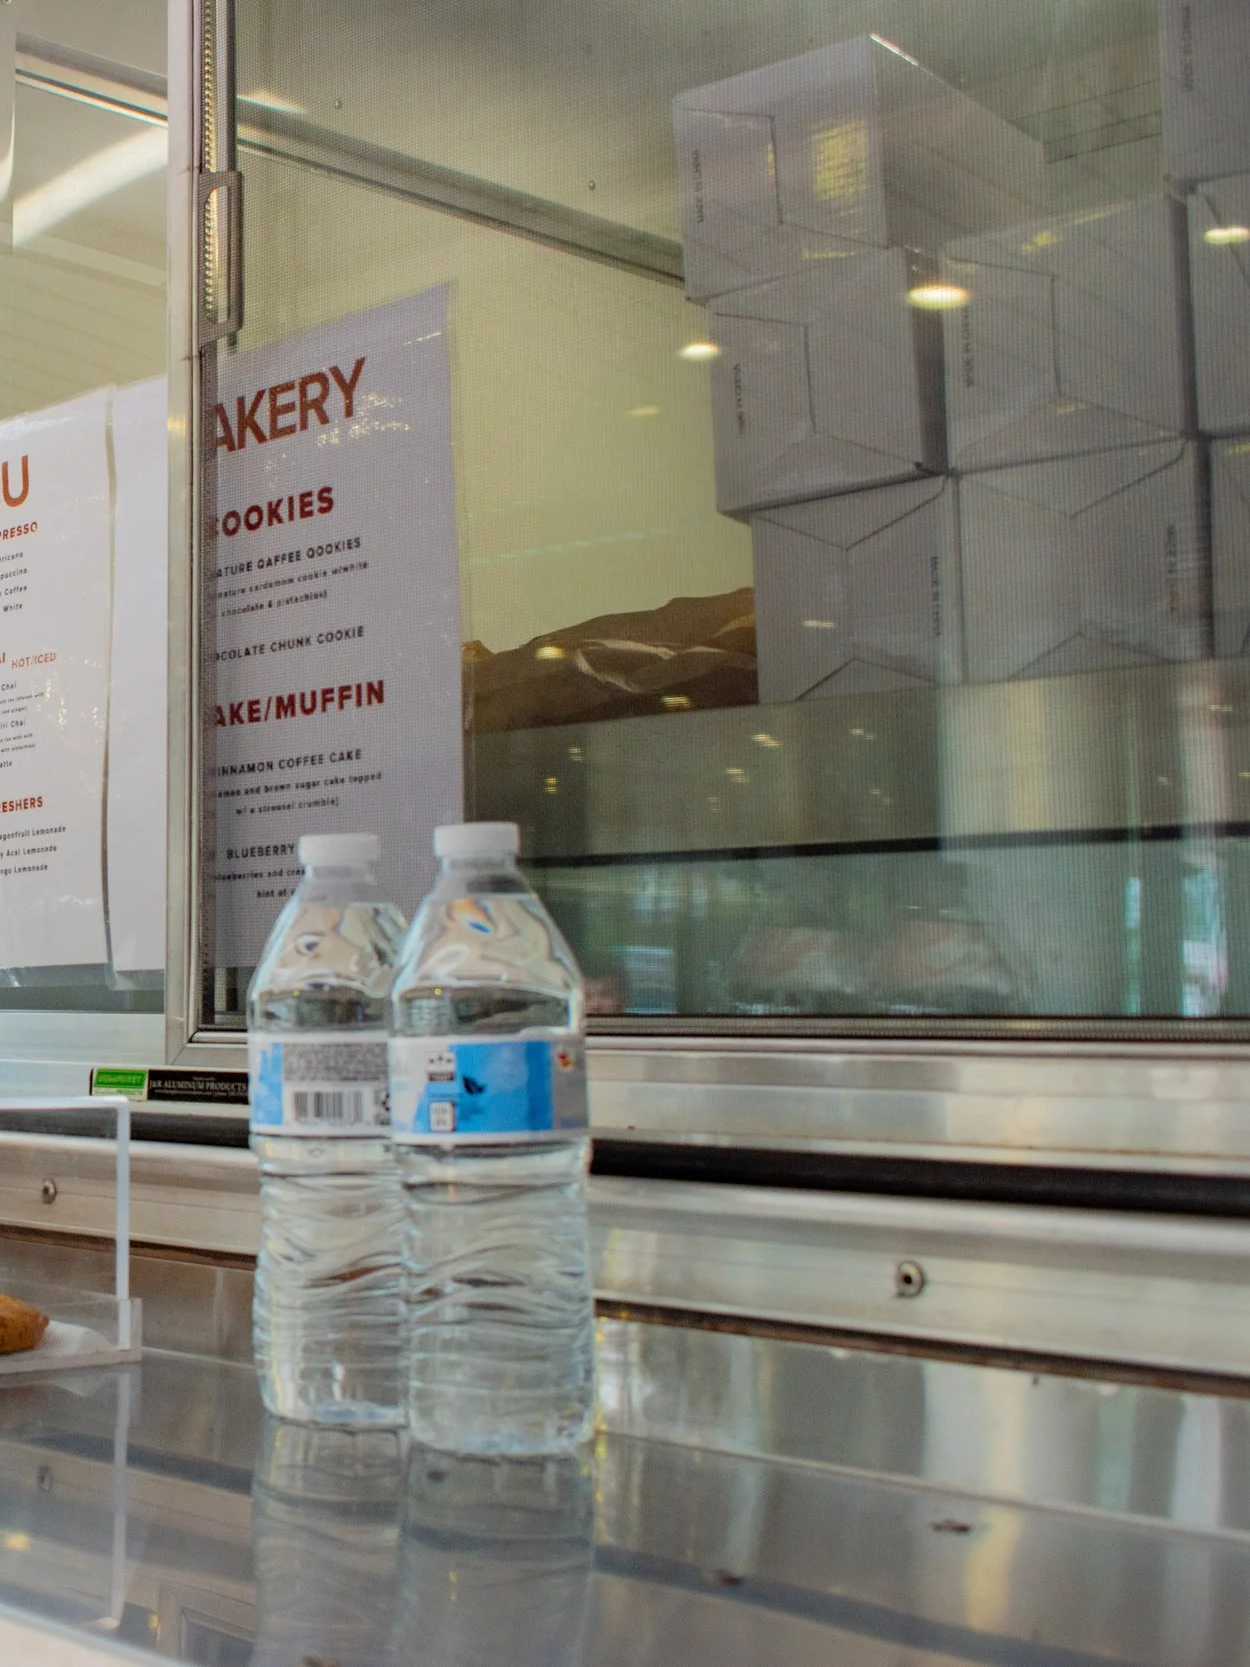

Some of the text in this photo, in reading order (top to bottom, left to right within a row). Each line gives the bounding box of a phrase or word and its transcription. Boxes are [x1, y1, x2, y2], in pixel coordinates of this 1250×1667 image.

[214, 356, 366, 452] AKERY
[216, 562, 253, 577] ATURE
[257, 550, 301, 569] QAFFEE
[4, 585, 28, 596] Coffee
[217, 588, 246, 598] nature
[250, 578, 294, 593] cardamom
[297, 570, 328, 582] cookie
[3, 603, 23, 613] White
[214, 626, 364, 662] OCOLATE CHUNK COOKIE
[11, 652, 56, 669] HOT/ICED
[1, 681, 17, 691] Chai
[214, 680, 385, 727] AKE/MUFFIN
[10, 720, 26, 728] Chai
[217, 749, 362, 777] INNAMON COFFEE CAKE
[245, 786, 260, 795] and
[264, 782, 291, 793] brown
[295, 780, 320, 791] sugar
[324, 775, 345, 786] cake
[349, 771, 382, 784] topped
[32, 825, 66, 836] Lemonade
[6, 849, 21, 857] Acai
[23, 845, 57, 855] Lemonade
[226, 843, 294, 859] BLUEBERRY
[14, 863, 48, 873] Lemonade
[215, 868, 305, 881] lueberries and crea
[163, 1079, 205, 1090] ALUMINUM
[205, 1081, 247, 1092] PRODUCTS
